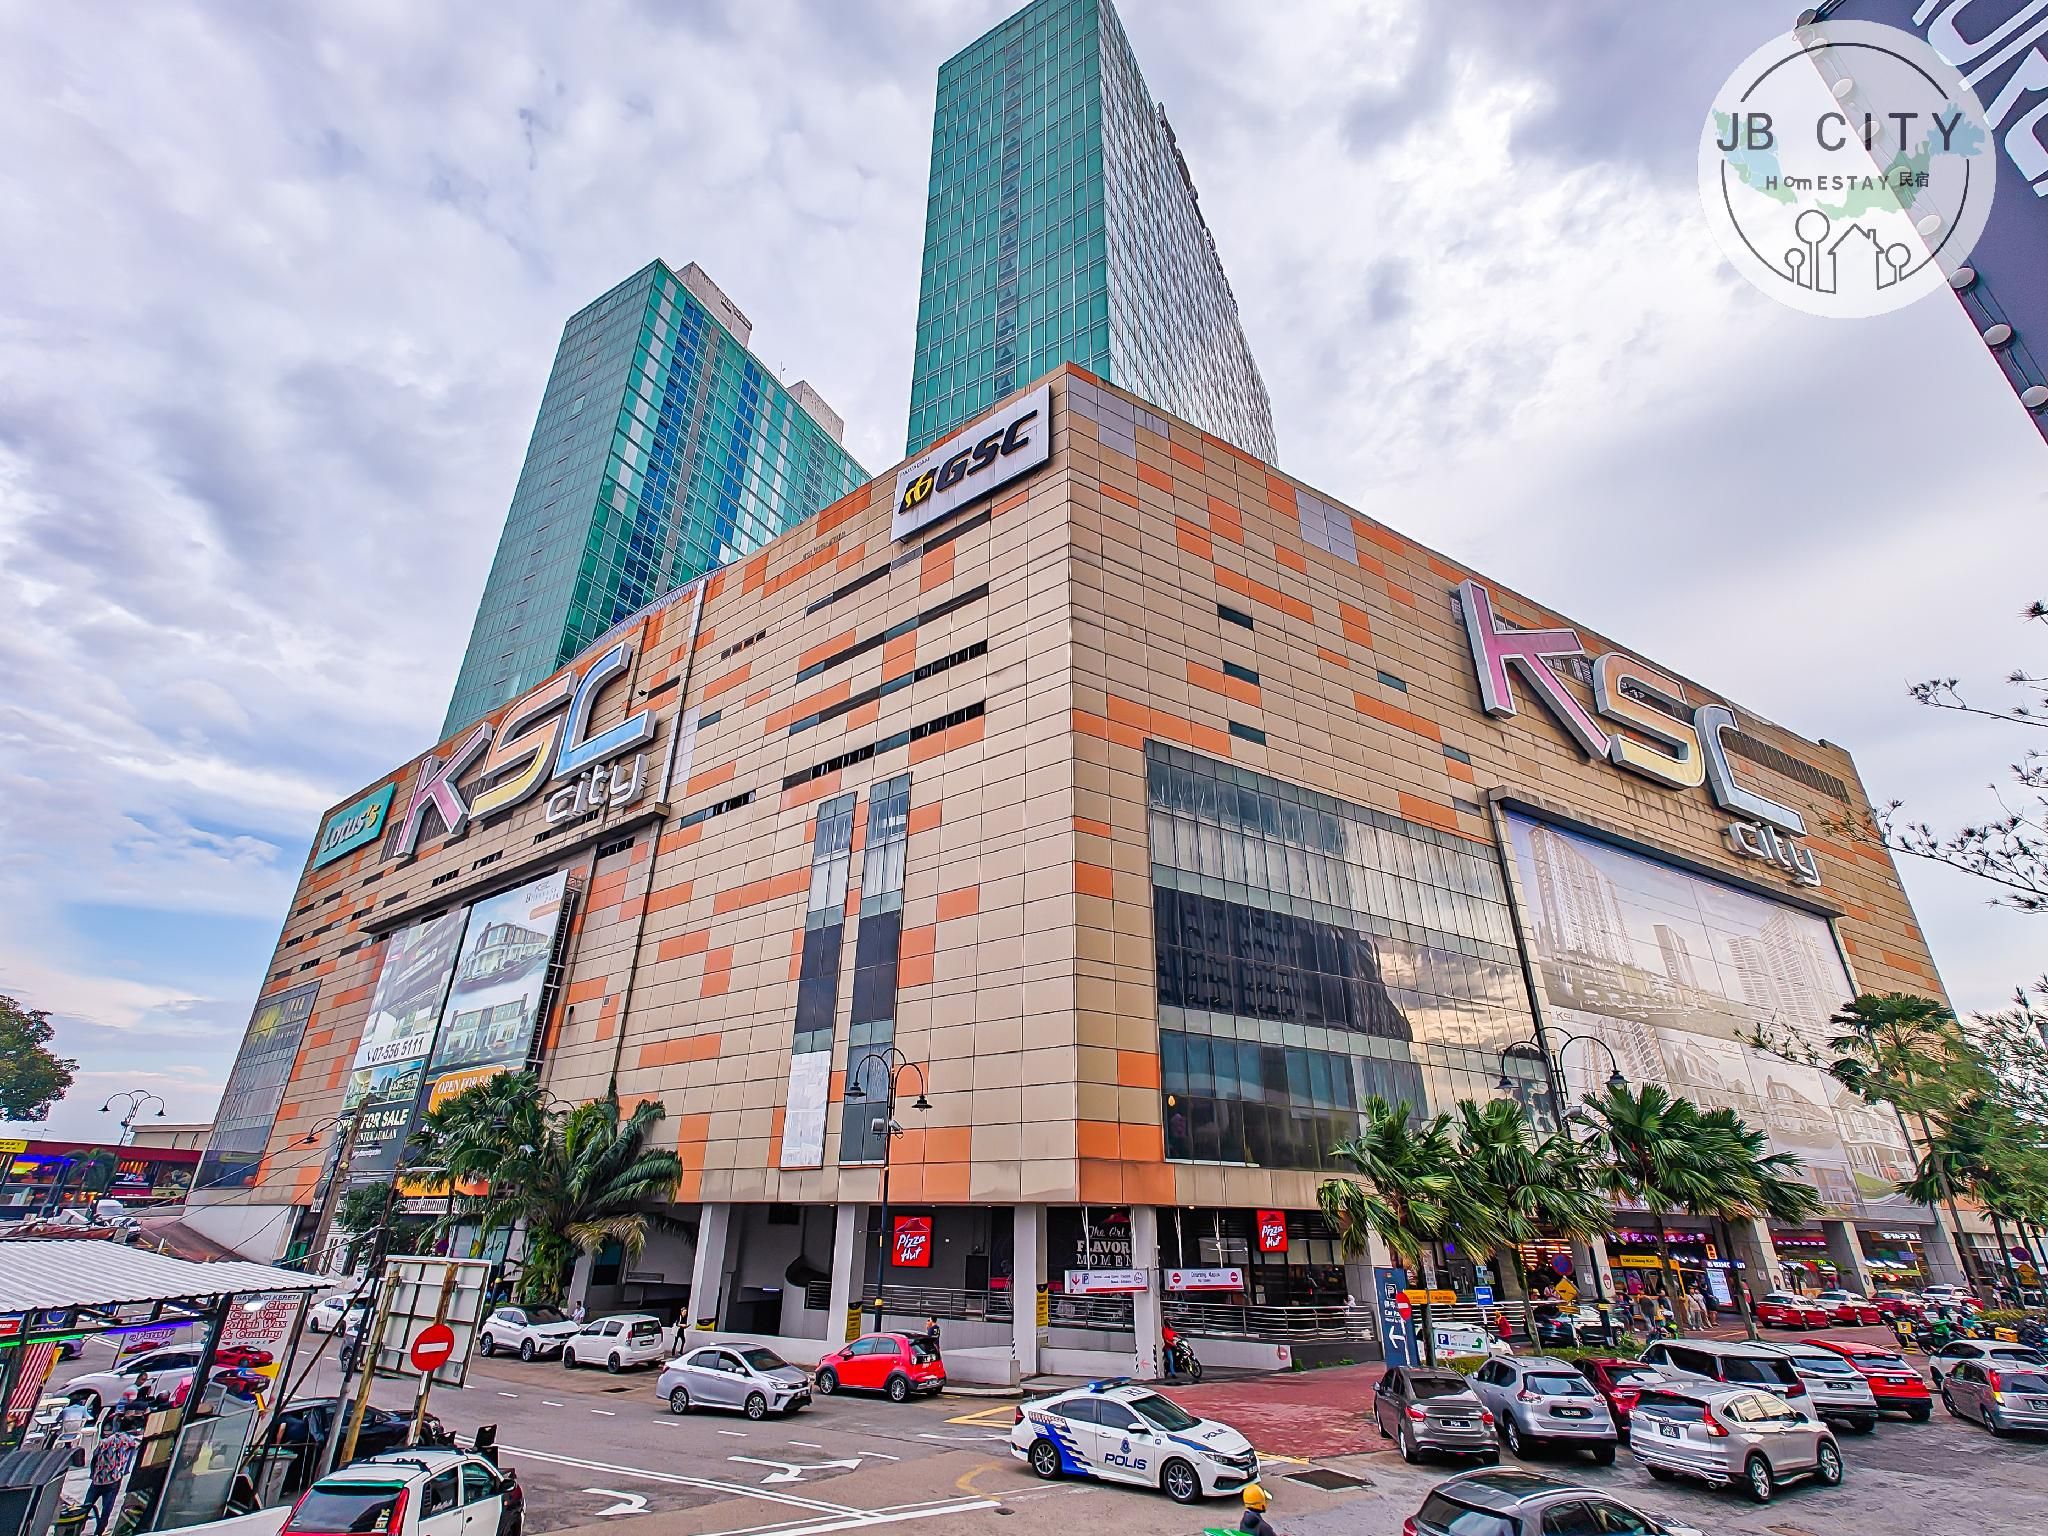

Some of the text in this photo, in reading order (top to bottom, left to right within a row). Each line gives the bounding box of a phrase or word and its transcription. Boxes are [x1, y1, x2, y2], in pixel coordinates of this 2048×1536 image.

[935, 409, 1038, 493] GSC
[545, 752, 648, 824] city
[1728, 820, 1822, 887] city
[360, 1112, 382, 1129] FOR
[381, 1109, 409, 1127] SALE
[901, 1247, 923, 1262] Hut
[1077, 1240, 1131, 1254] FAVOR
[265, 1301, 299, 1311] Clean
[230, 1310, 287, 1320] Car Wash
[224, 1319, 288, 1330] Polish Wax
[236, 1328, 283, 1340] Coating
[1104, 1453, 1147, 1470] POLIS
